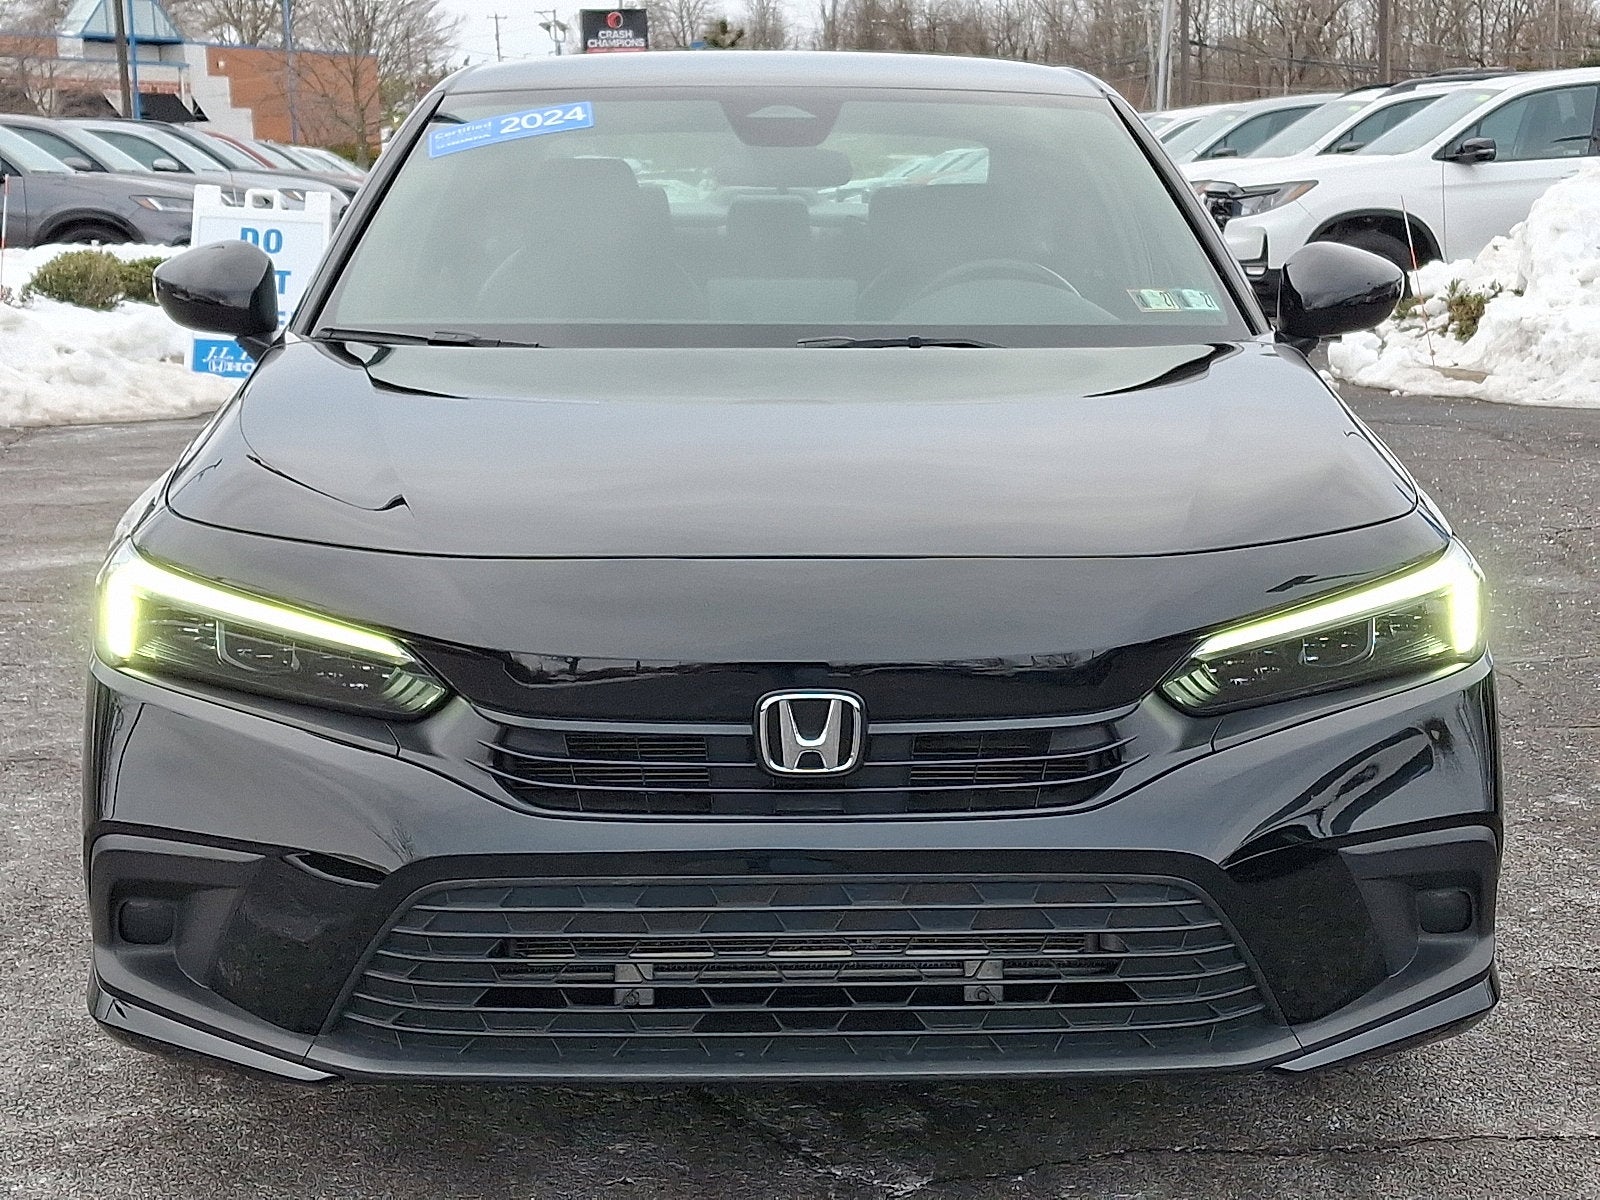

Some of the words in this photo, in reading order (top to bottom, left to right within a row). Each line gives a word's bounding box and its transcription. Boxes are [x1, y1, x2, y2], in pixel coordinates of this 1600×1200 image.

[587, 38, 645, 48] CHAMPIONS
[598, 29, 633, 39] CRASH
[435, 121, 492, 140] Certified
[500, 106, 587, 134] 2024
[241, 227, 283, 253] DO
